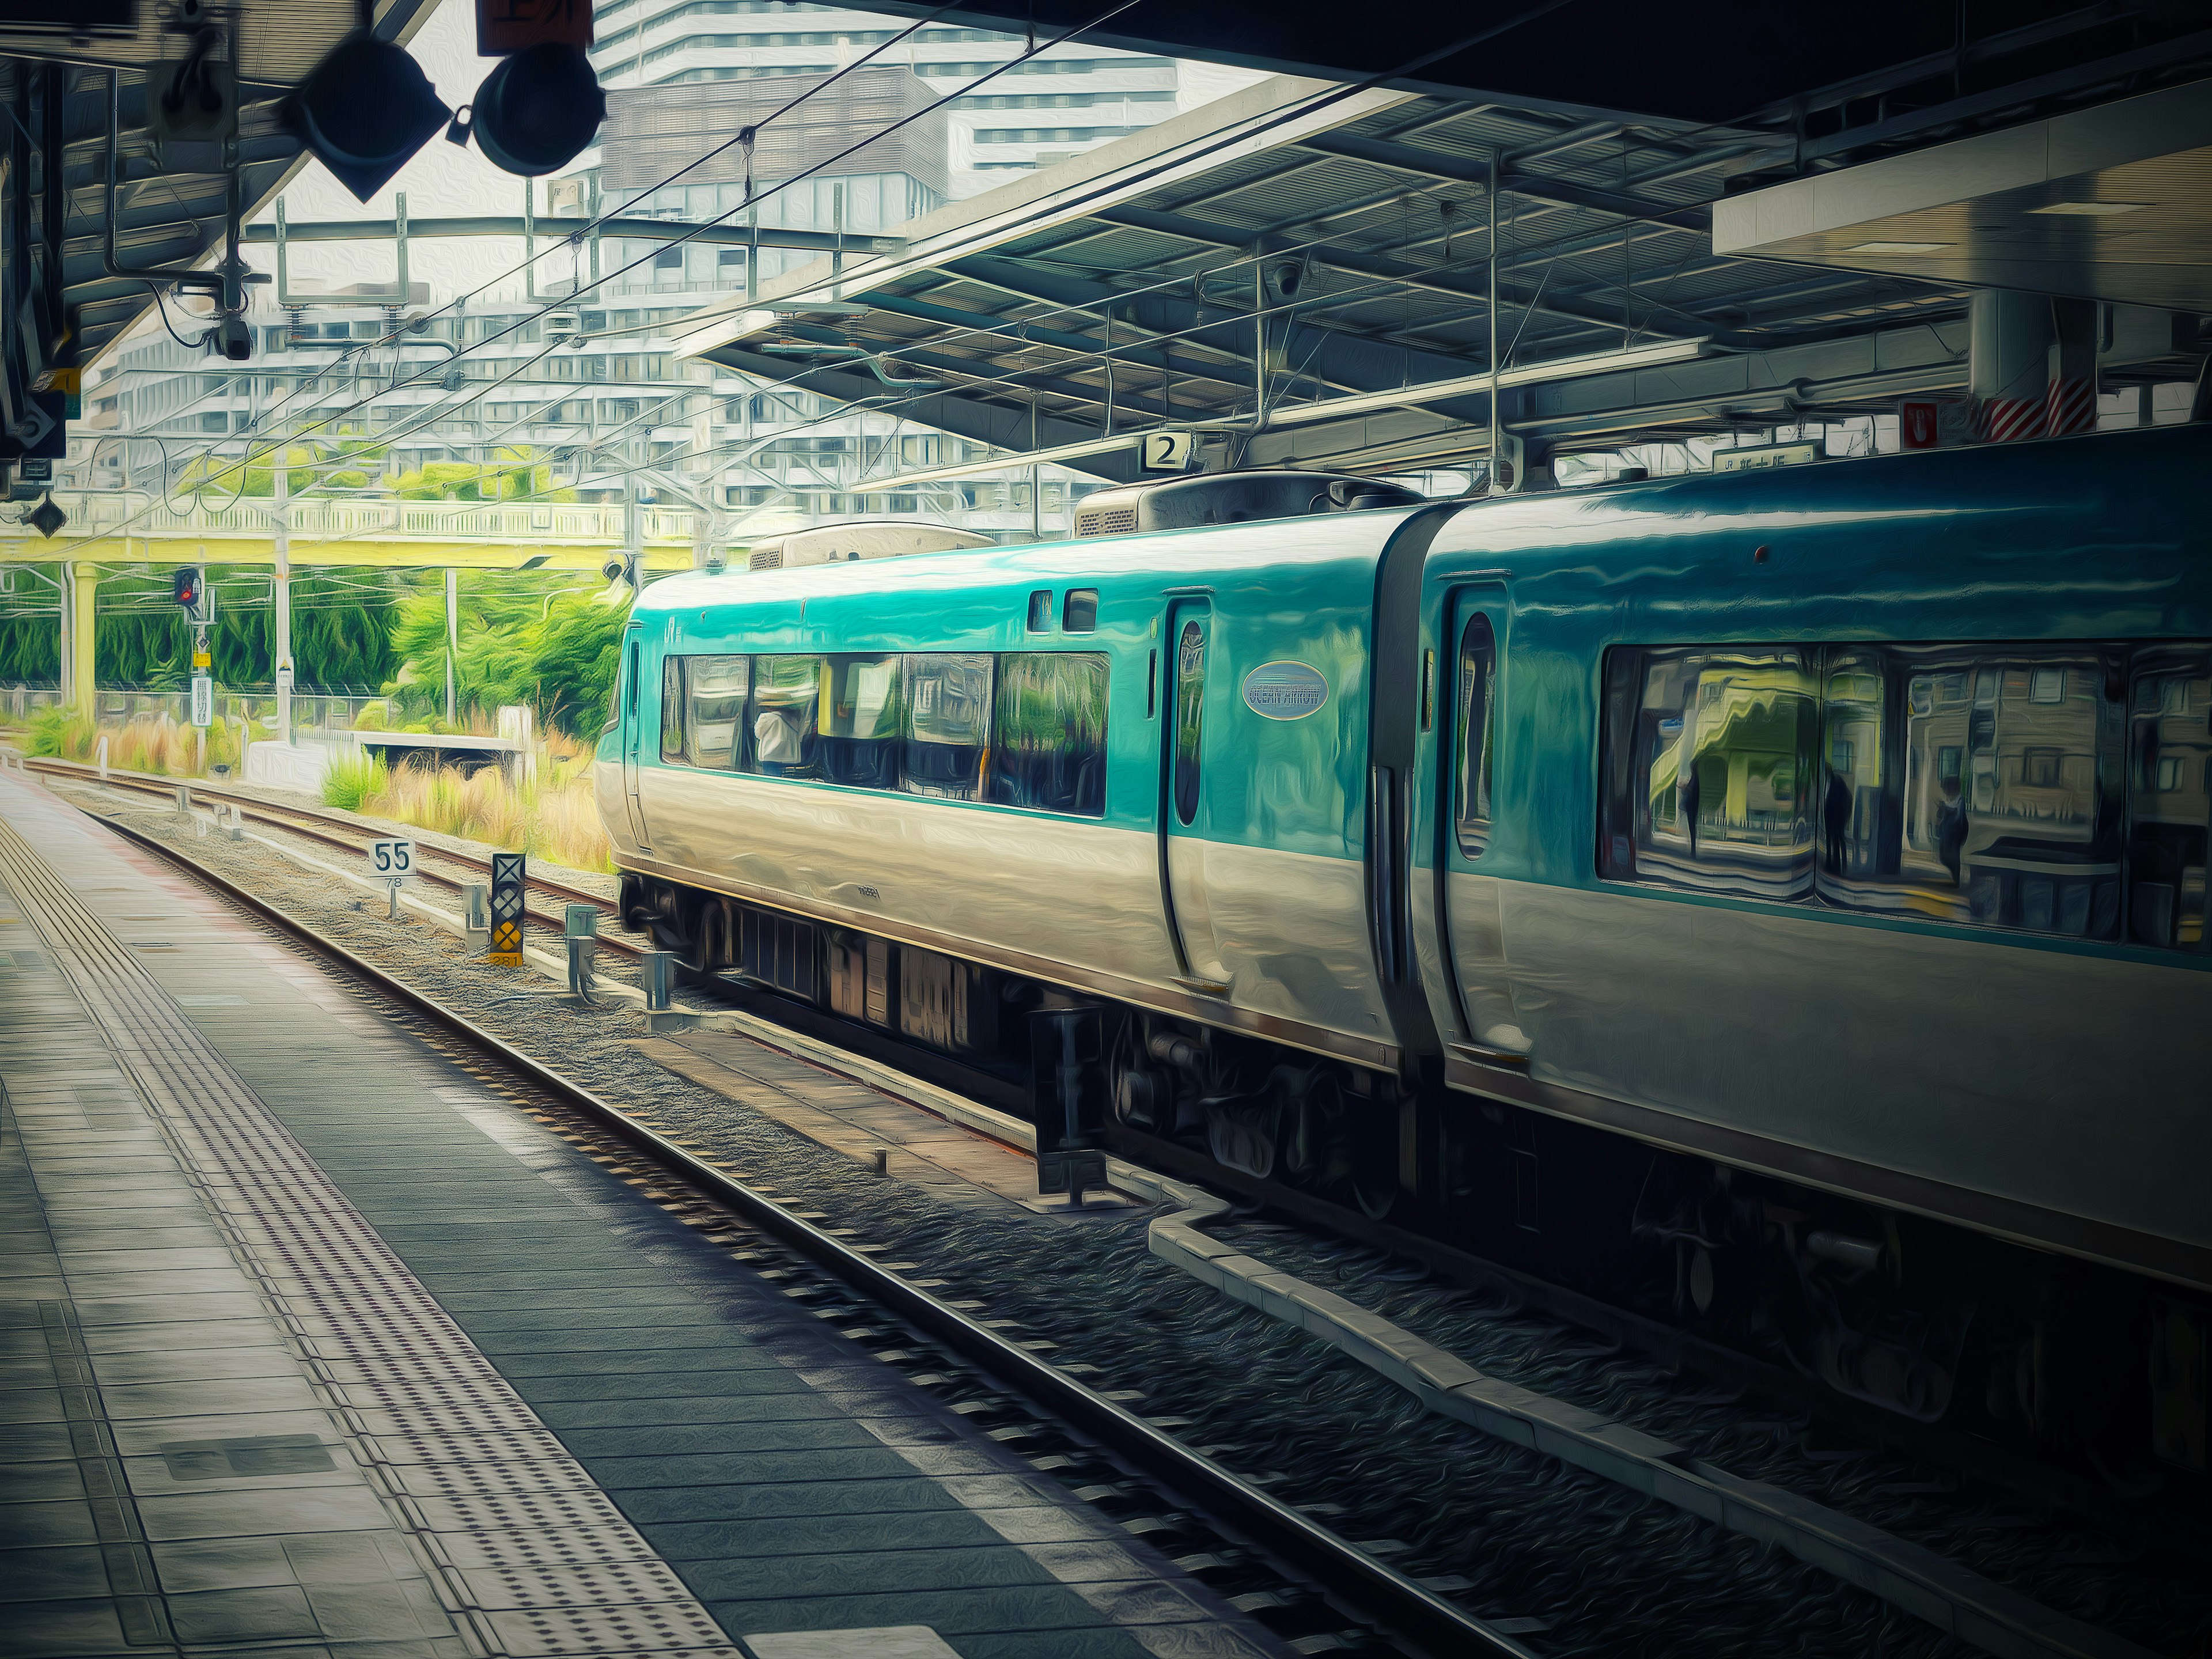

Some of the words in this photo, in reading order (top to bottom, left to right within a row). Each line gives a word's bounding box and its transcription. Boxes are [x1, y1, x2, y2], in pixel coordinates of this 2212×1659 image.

[1157, 436, 1176, 464] 2
[1725, 460, 1733, 470] JR
[1249, 684, 1282, 704] OCEAN
[1283, 684, 1321, 704] ARROW
[375, 842, 410, 871] 55
[384, 877, 402, 888] 78
